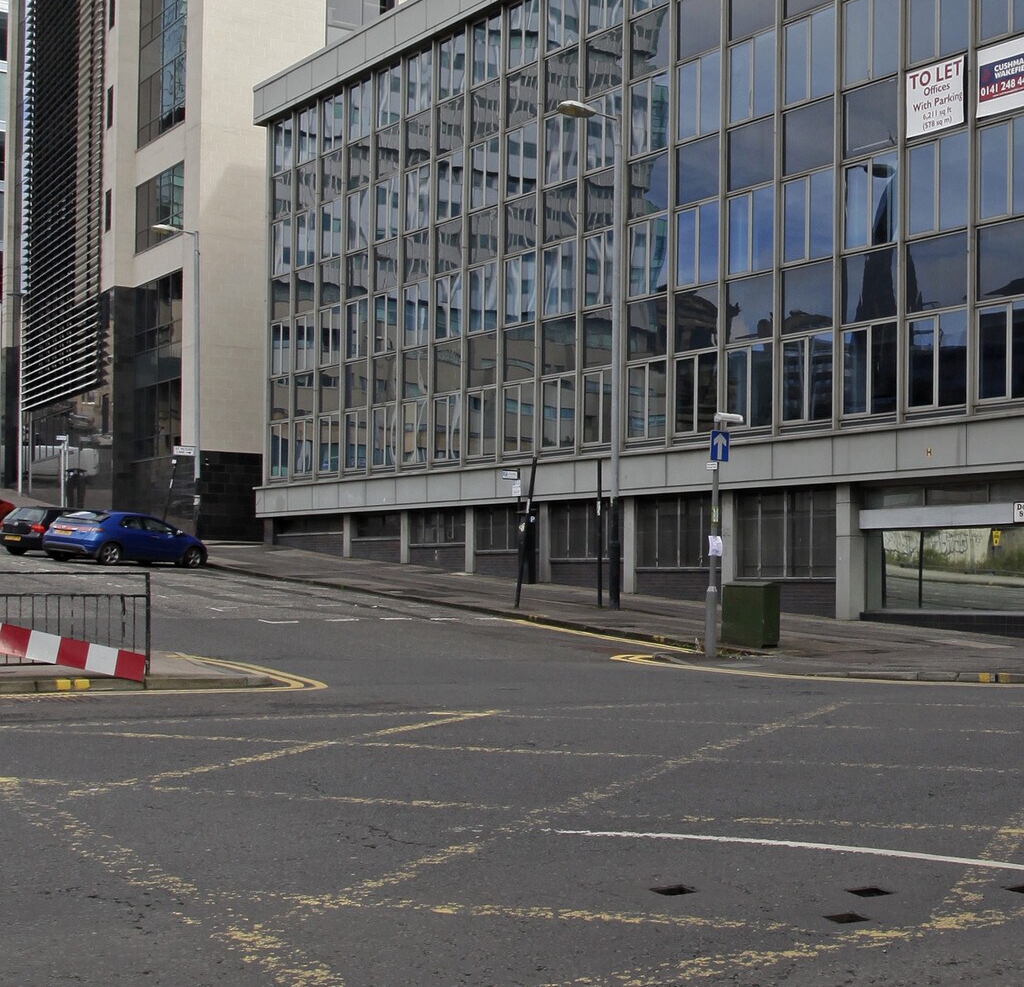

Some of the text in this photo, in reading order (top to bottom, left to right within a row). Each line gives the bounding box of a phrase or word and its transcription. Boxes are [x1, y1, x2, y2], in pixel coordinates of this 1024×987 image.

[909, 59, 962, 90] TO LET
[923, 83, 950, 96] Offices
[980, 83, 998, 96] 0141
[1000, 79, 1016, 91] 248
[912, 91, 963, 113] With Parking
